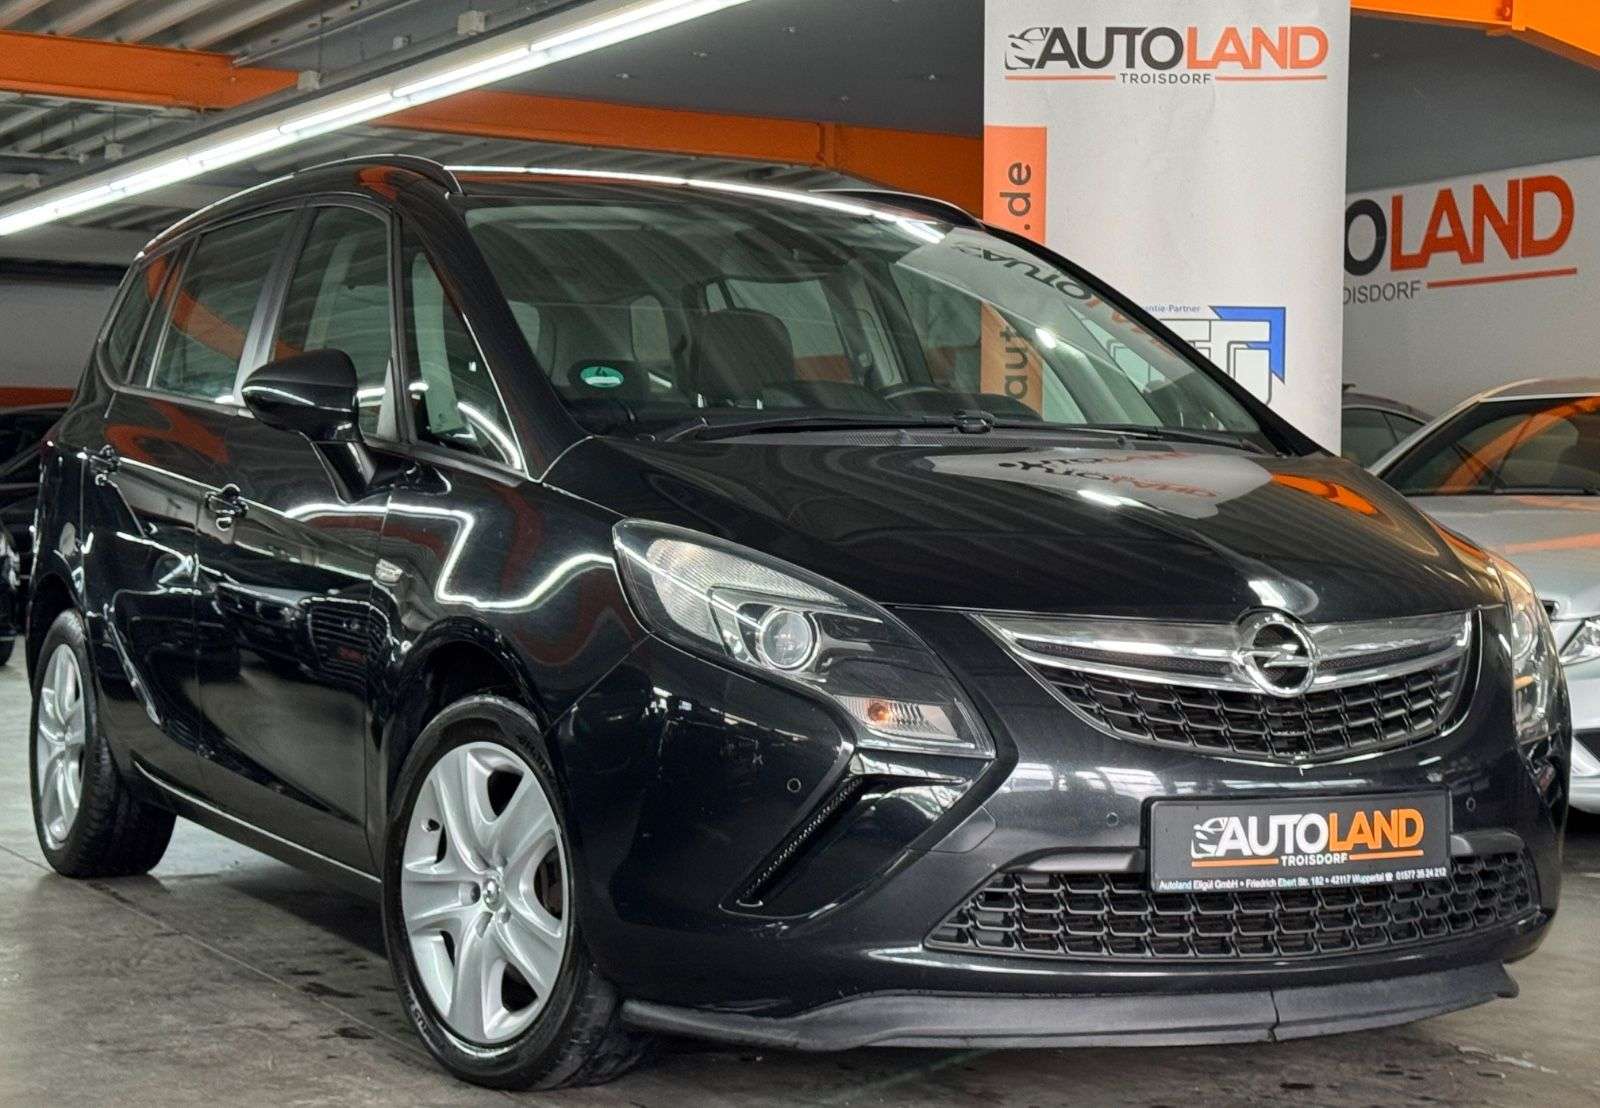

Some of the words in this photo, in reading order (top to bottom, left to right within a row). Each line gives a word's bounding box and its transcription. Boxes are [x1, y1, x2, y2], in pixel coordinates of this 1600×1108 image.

[1035, 26, 1329, 71] AUTOLAND
[1120, 72, 1211, 85] TROISDORF
[1215, 808, 1424, 857] AUTOLAND
[1281, 853, 1348, 867] TROISDORF
[1159, 879, 1192, 890] Autoland
[1214, 879, 1239, 889] GmbH
[1246, 878, 1277, 889] Friedrich
[1330, 874, 1351, 885] 42117
[1351, 872, 1385, 885] Wuppertal
